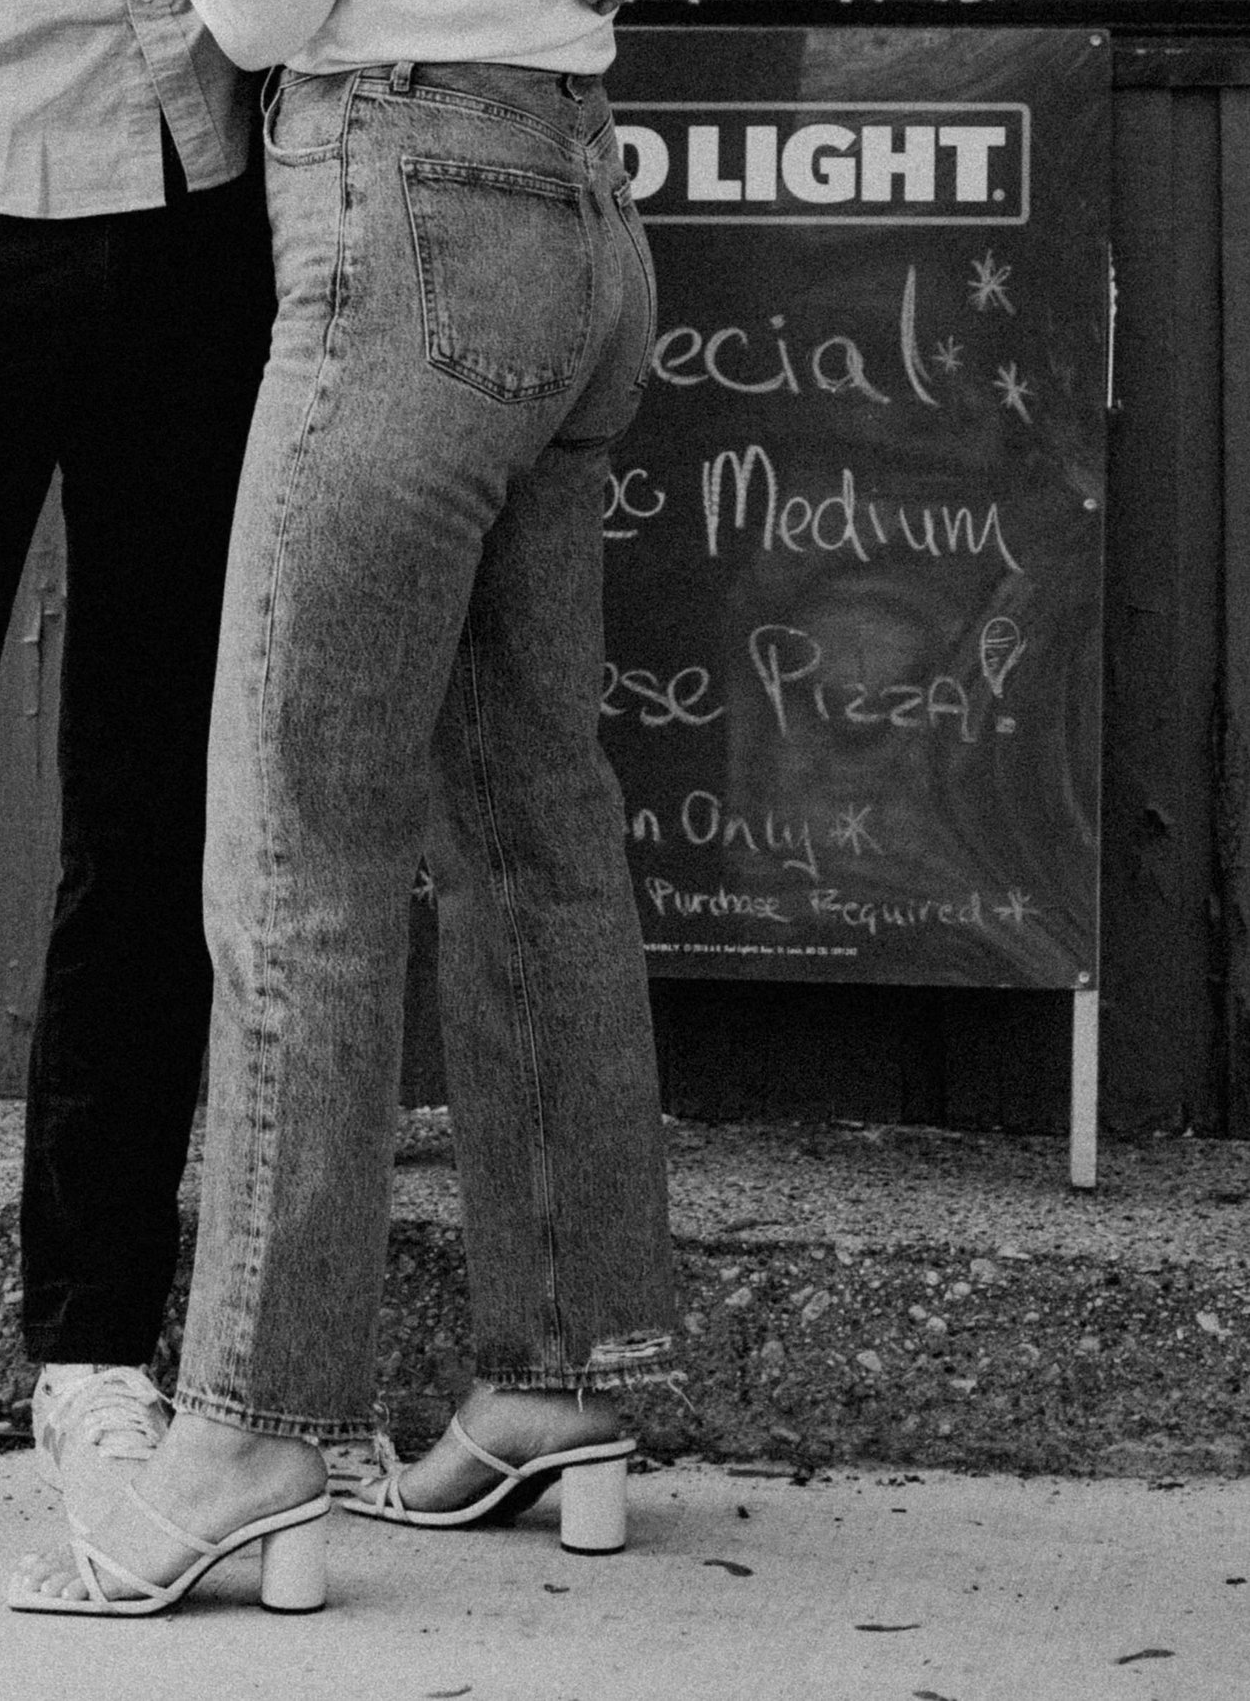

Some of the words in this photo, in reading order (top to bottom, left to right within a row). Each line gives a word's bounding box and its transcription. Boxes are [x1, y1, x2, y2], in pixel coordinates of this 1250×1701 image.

[613, 124, 669, 201] D
[652, 263, 940, 407] ecial
[702, 443, 1025, 574] Medium
[598, 663, 725, 726] ese
[681, 790, 820, 880] Only
[809, 888, 983, 936] Required
